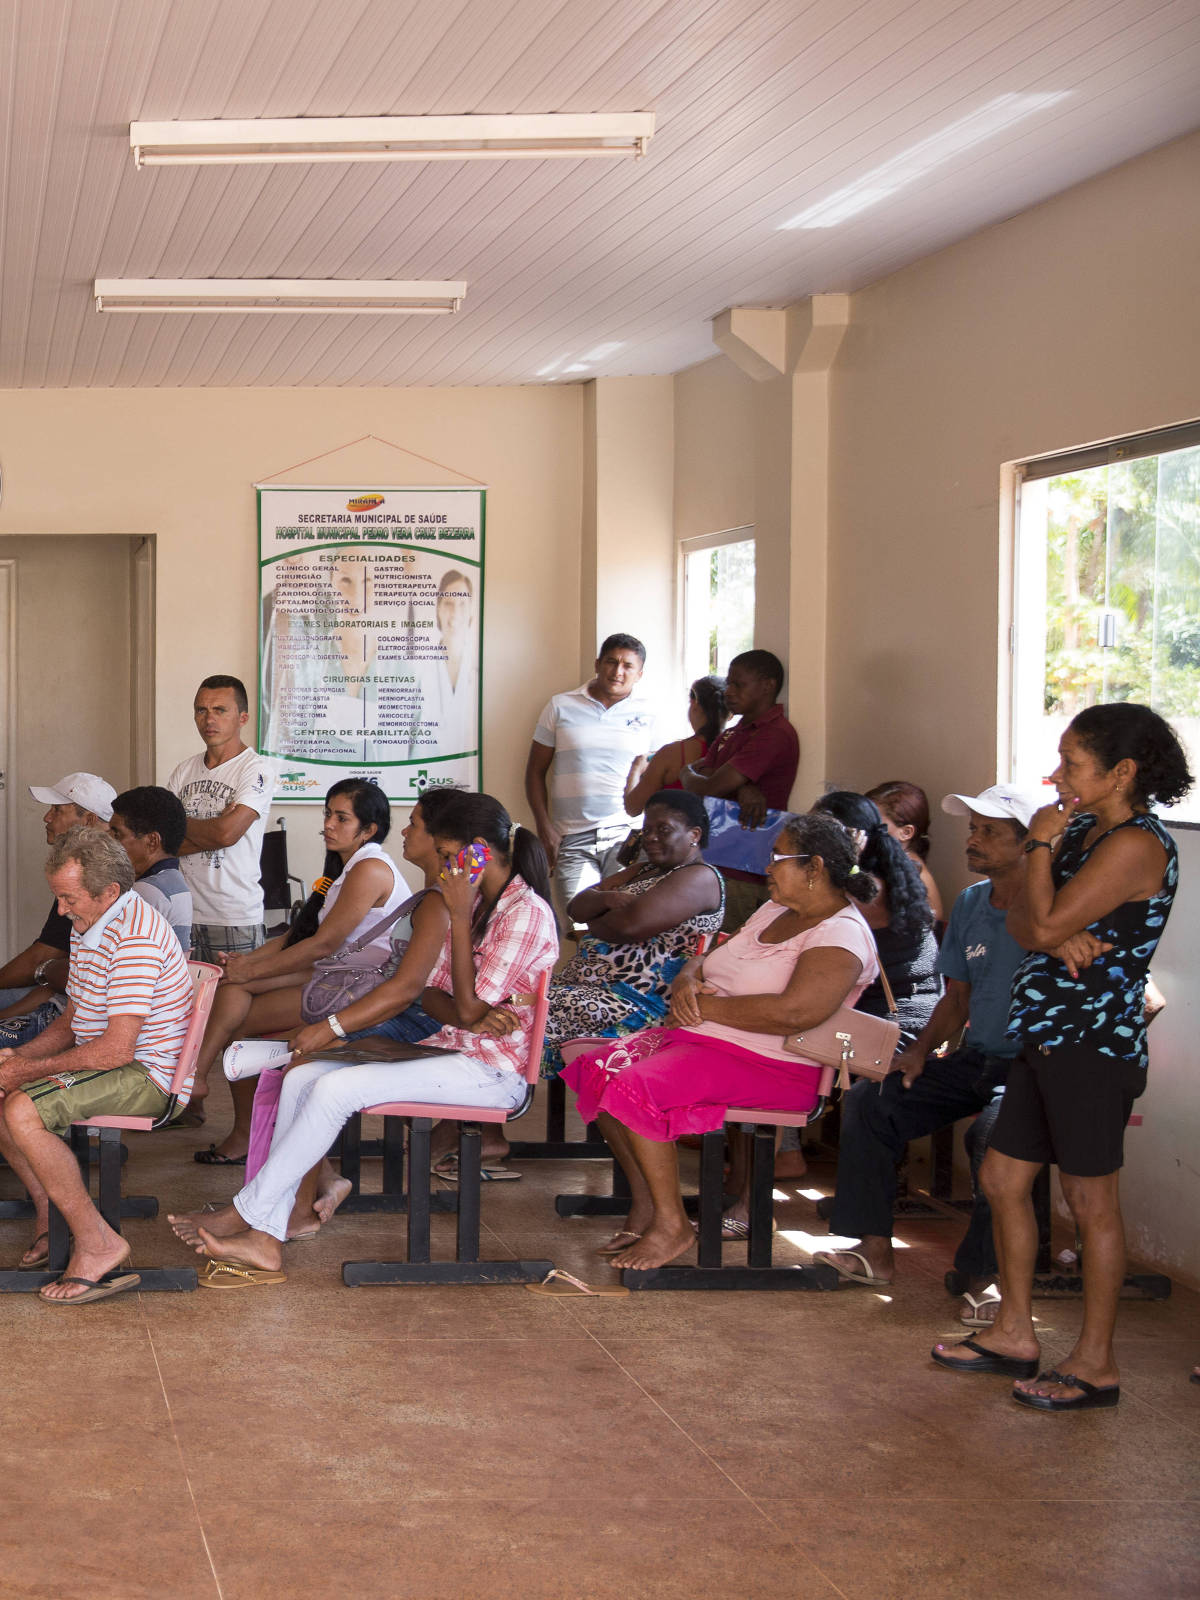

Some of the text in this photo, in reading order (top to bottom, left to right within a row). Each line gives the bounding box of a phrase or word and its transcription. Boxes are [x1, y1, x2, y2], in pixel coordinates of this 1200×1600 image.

[298, 512, 447, 523] SECRETARIA MUNICIPAL DE SAÚDE
[275, 526, 476, 540] HOSPITAL MUNICIPAL PEDRO VERA CRUZ BEZERRA
[323, 620, 388, 628] LABORATORIAIS
[391, 620, 396, 628] E
[401, 620, 434, 628] IMAGEM
[322, 675, 415, 683] CIRURGIAS ELETIVAS
[428, 777, 454, 785] SUS
